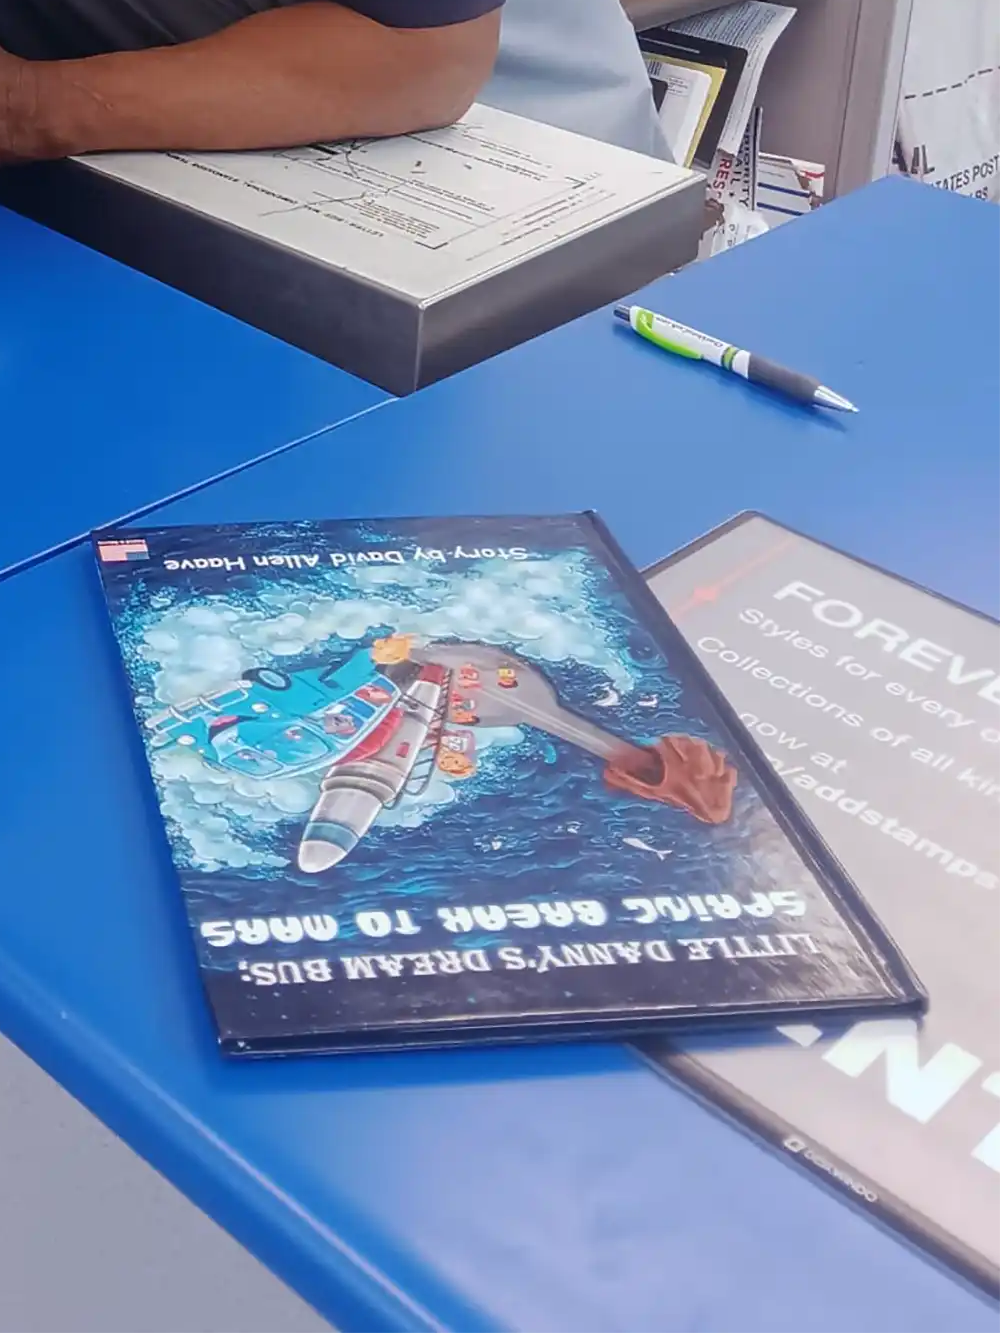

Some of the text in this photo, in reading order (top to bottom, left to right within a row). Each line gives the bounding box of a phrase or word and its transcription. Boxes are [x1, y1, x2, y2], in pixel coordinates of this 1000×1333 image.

[163, 546, 528, 571] Story by David Allen Haave
[739, 606, 975, 729] Styles for every
[696, 636, 864, 729] Collections
[870, 723, 913, 748] of
[911, 744, 955, 772] all
[810, 752, 847, 774] at
[201, 914, 338, 947] MARS
[356, 909, 421, 937] TO
[437, 900, 608, 933] BREAK
[678, 933, 822, 960] LITTLE
[340, 950, 492, 980] DREAM
